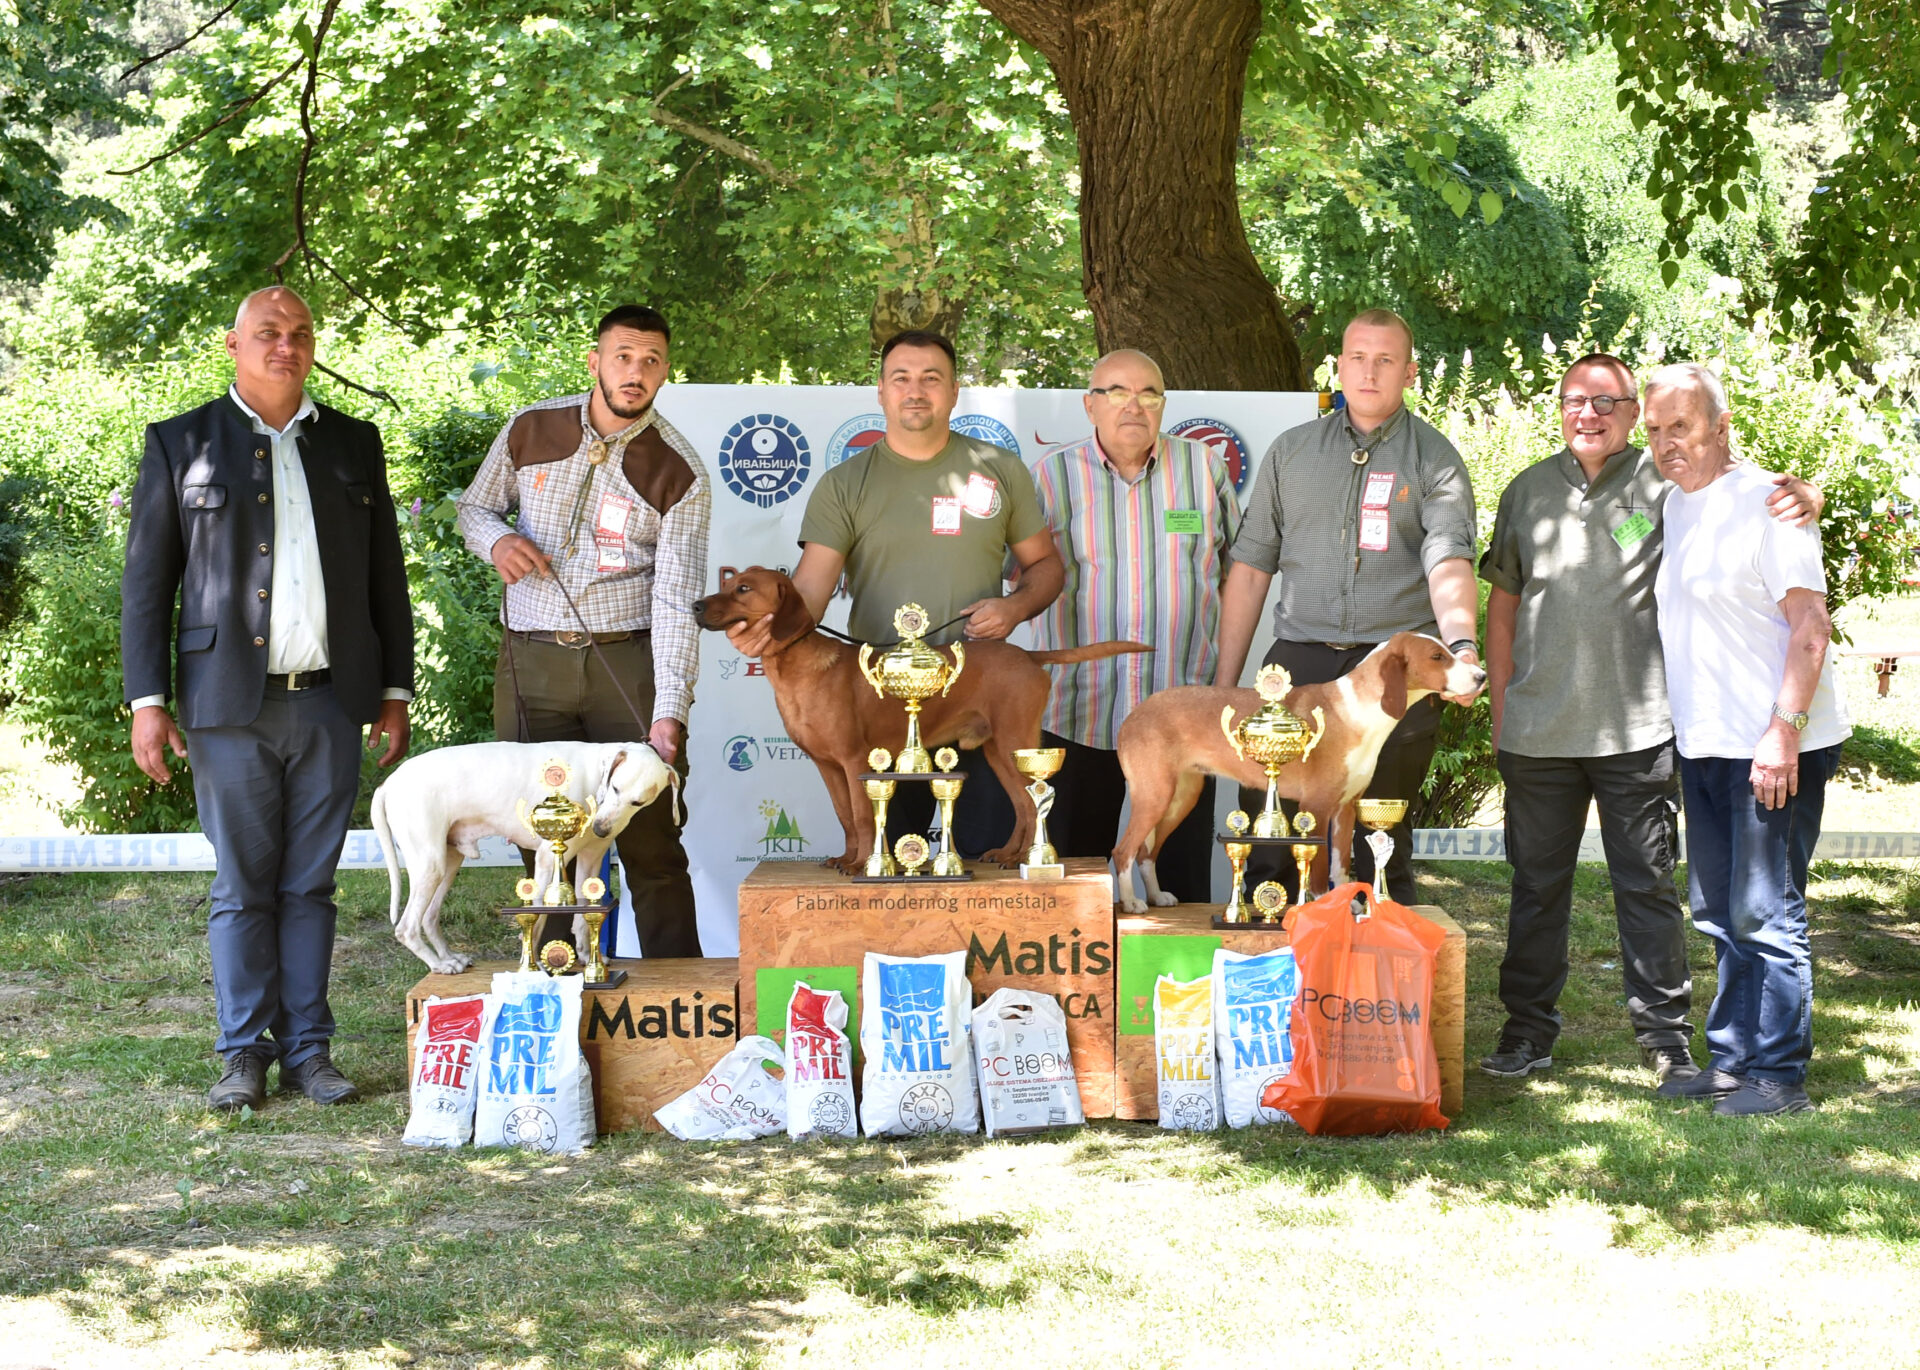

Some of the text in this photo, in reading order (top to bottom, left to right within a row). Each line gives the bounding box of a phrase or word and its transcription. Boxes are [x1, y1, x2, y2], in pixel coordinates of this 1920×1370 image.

[949, 416, 1000, 430] OLOGIQUE
[1169, 420, 1206, 435] ОРТСКИ
[734, 458, 797, 470] ИВАЊИЦА
[765, 746, 810, 760] VETA
[797, 893, 1057, 912] Fabrika modernog nameštaja
[965, 928, 1112, 976] Matis
[586, 991, 735, 1041] Matis
[1302, 988, 1343, 1021] PC
[881, 1010, 950, 1044] PRE
[421, 1043, 473, 1067] PRE
[489, 1033, 556, 1065] PRE
[793, 1035, 842, 1059] PRE
[1161, 1032, 1210, 1056] PRE
[793, 1056, 847, 1083] MIL
[881, 1041, 952, 1073] MIL
[980, 1056, 1011, 1077] PC
[1161, 1058, 1211, 1081] MIL
[417, 1063, 468, 1090] MIL
[487, 1063, 557, 1095] MIL
[700, 1074, 732, 1104] PC
[811, 1094, 838, 1117] MAXI
[902, 1085, 940, 1113] MAXI
[1174, 1096, 1202, 1118] MAXI
[506, 1109, 543, 1135] MAXI
